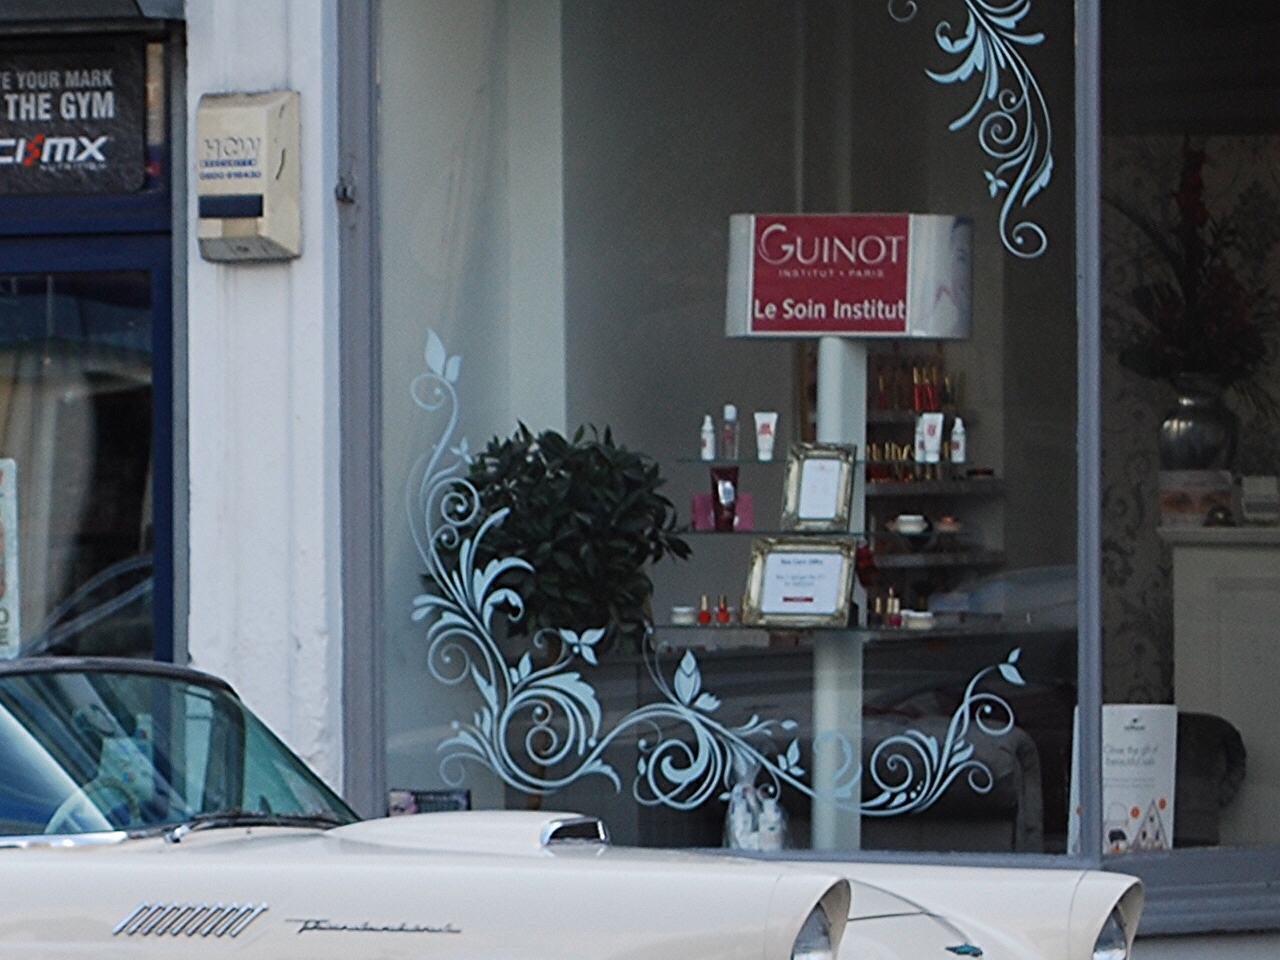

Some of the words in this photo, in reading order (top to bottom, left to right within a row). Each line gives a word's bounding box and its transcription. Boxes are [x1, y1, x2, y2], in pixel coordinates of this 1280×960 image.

[17, 70, 61, 89] YOUR
[65, 69, 114, 88] MARK
[4, 92, 53, 122] THE
[59, 91, 115, 121] GYM
[778, 269, 836, 278] INSTITUT
[848, 269, 885, 278] PARIS
[754, 300, 778, 320] Le
[782, 299, 826, 320] Soin
[833, 299, 908, 320] Institut
